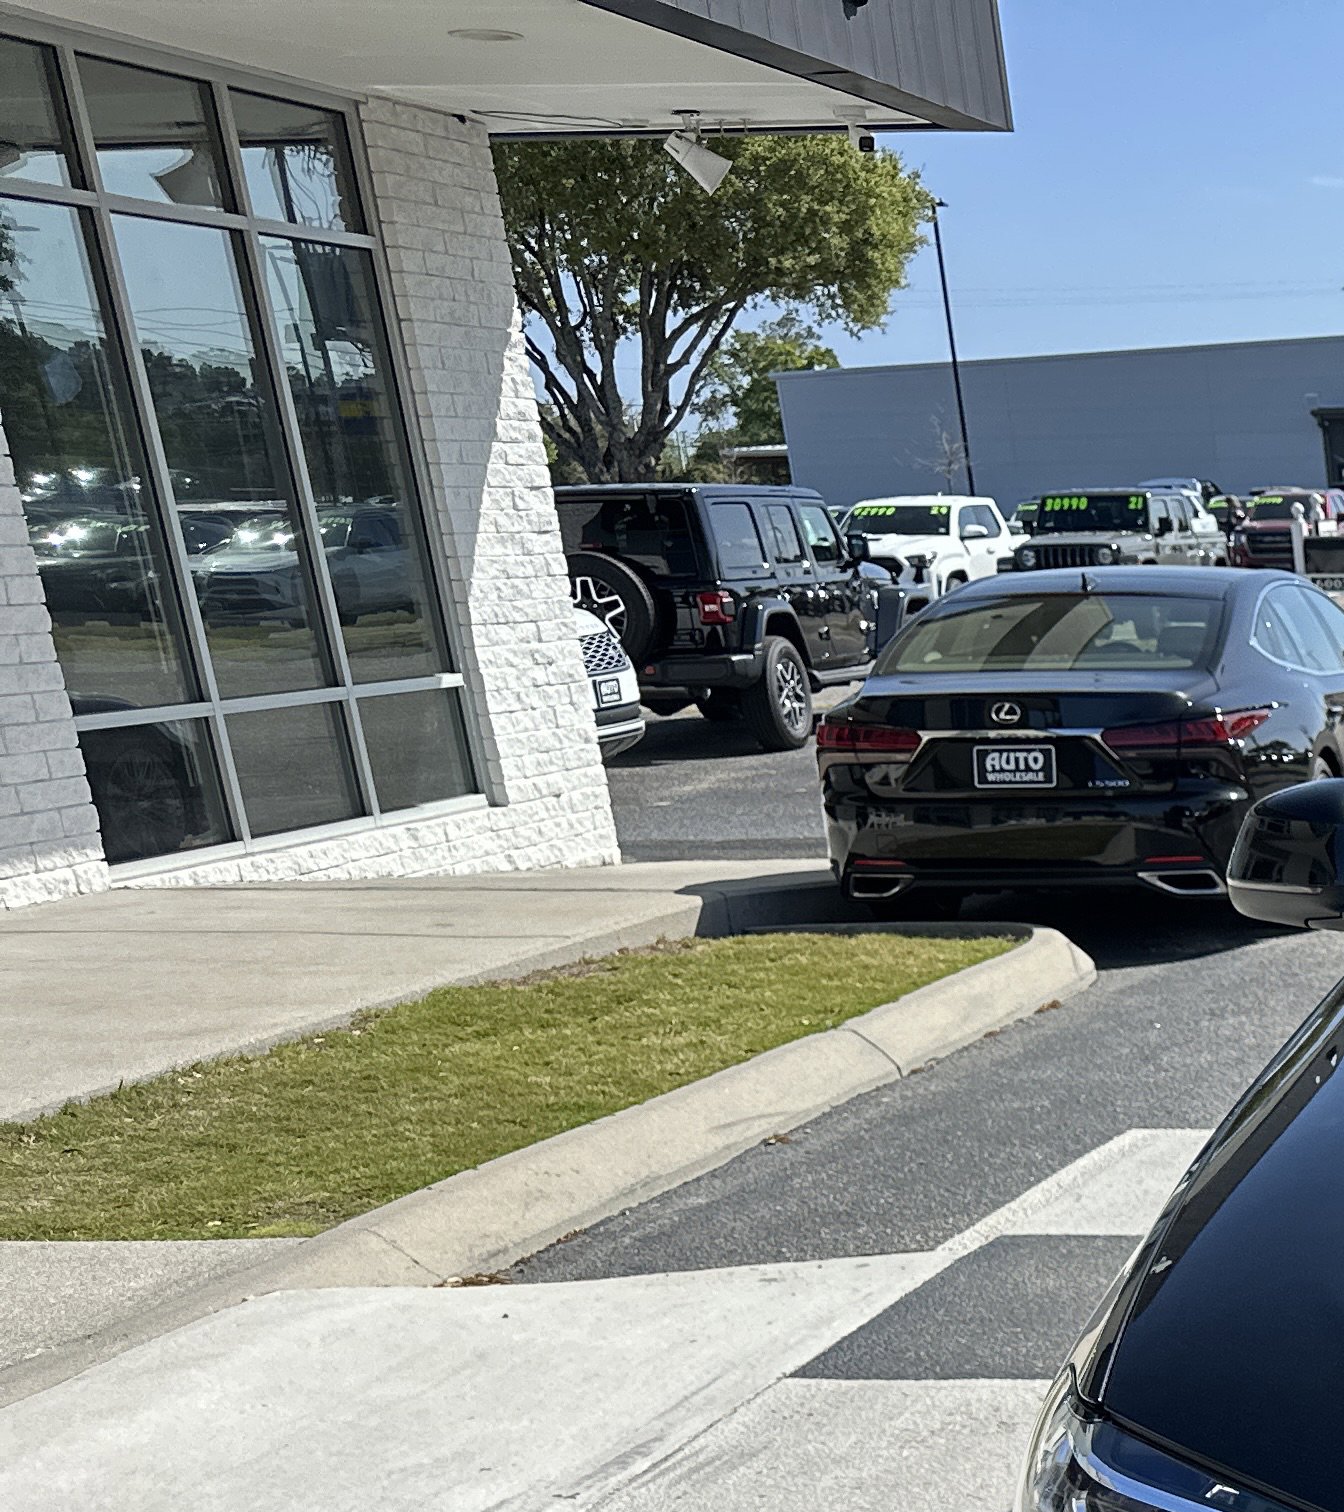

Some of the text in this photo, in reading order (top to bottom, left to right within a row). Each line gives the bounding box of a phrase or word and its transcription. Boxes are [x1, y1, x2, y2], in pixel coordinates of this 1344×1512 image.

[1128, 496, 1143, 510] 21
[985, 751, 1044, 772] AUTO
[986, 772, 1045, 782] WHOLESALE
